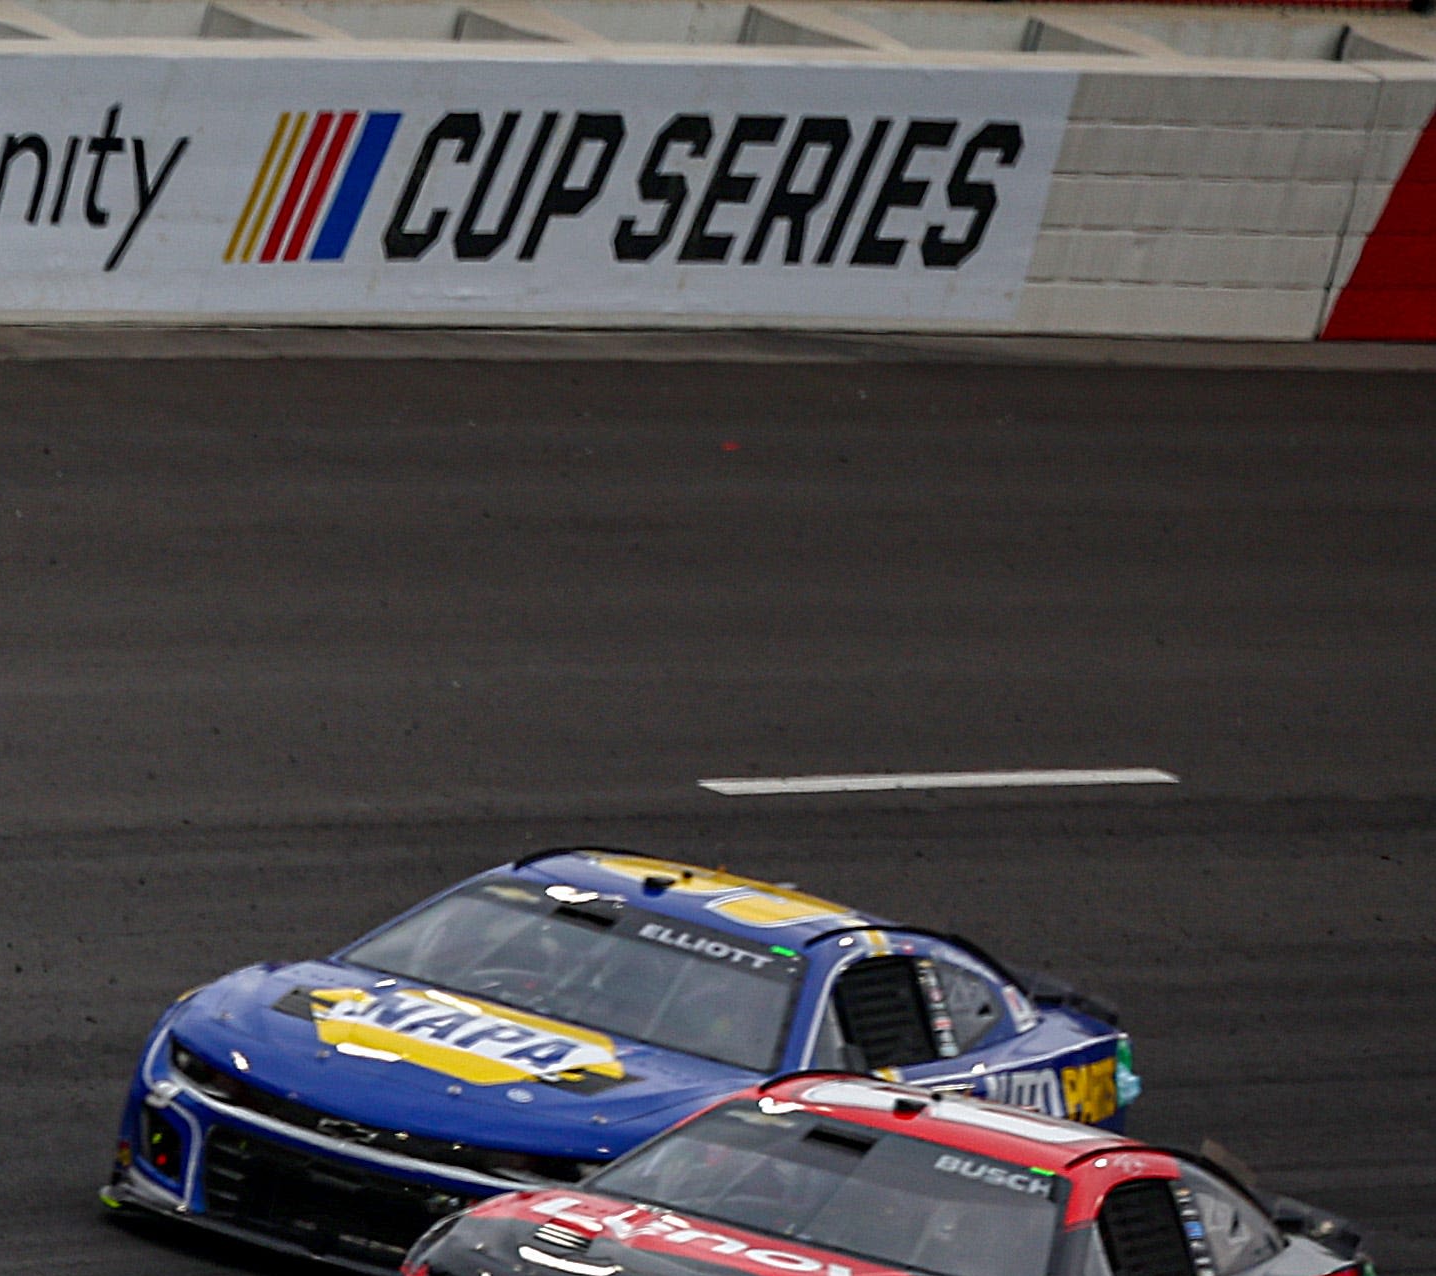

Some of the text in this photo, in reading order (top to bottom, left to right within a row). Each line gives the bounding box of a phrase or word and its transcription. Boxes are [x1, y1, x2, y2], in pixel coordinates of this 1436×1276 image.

[382, 111, 1025, 270] CUP SERIES
[638, 923, 775, 969] ELLIOTT
[365, 993, 579, 1070] NAPA
[932, 1155, 1054, 1196] BUSCH
